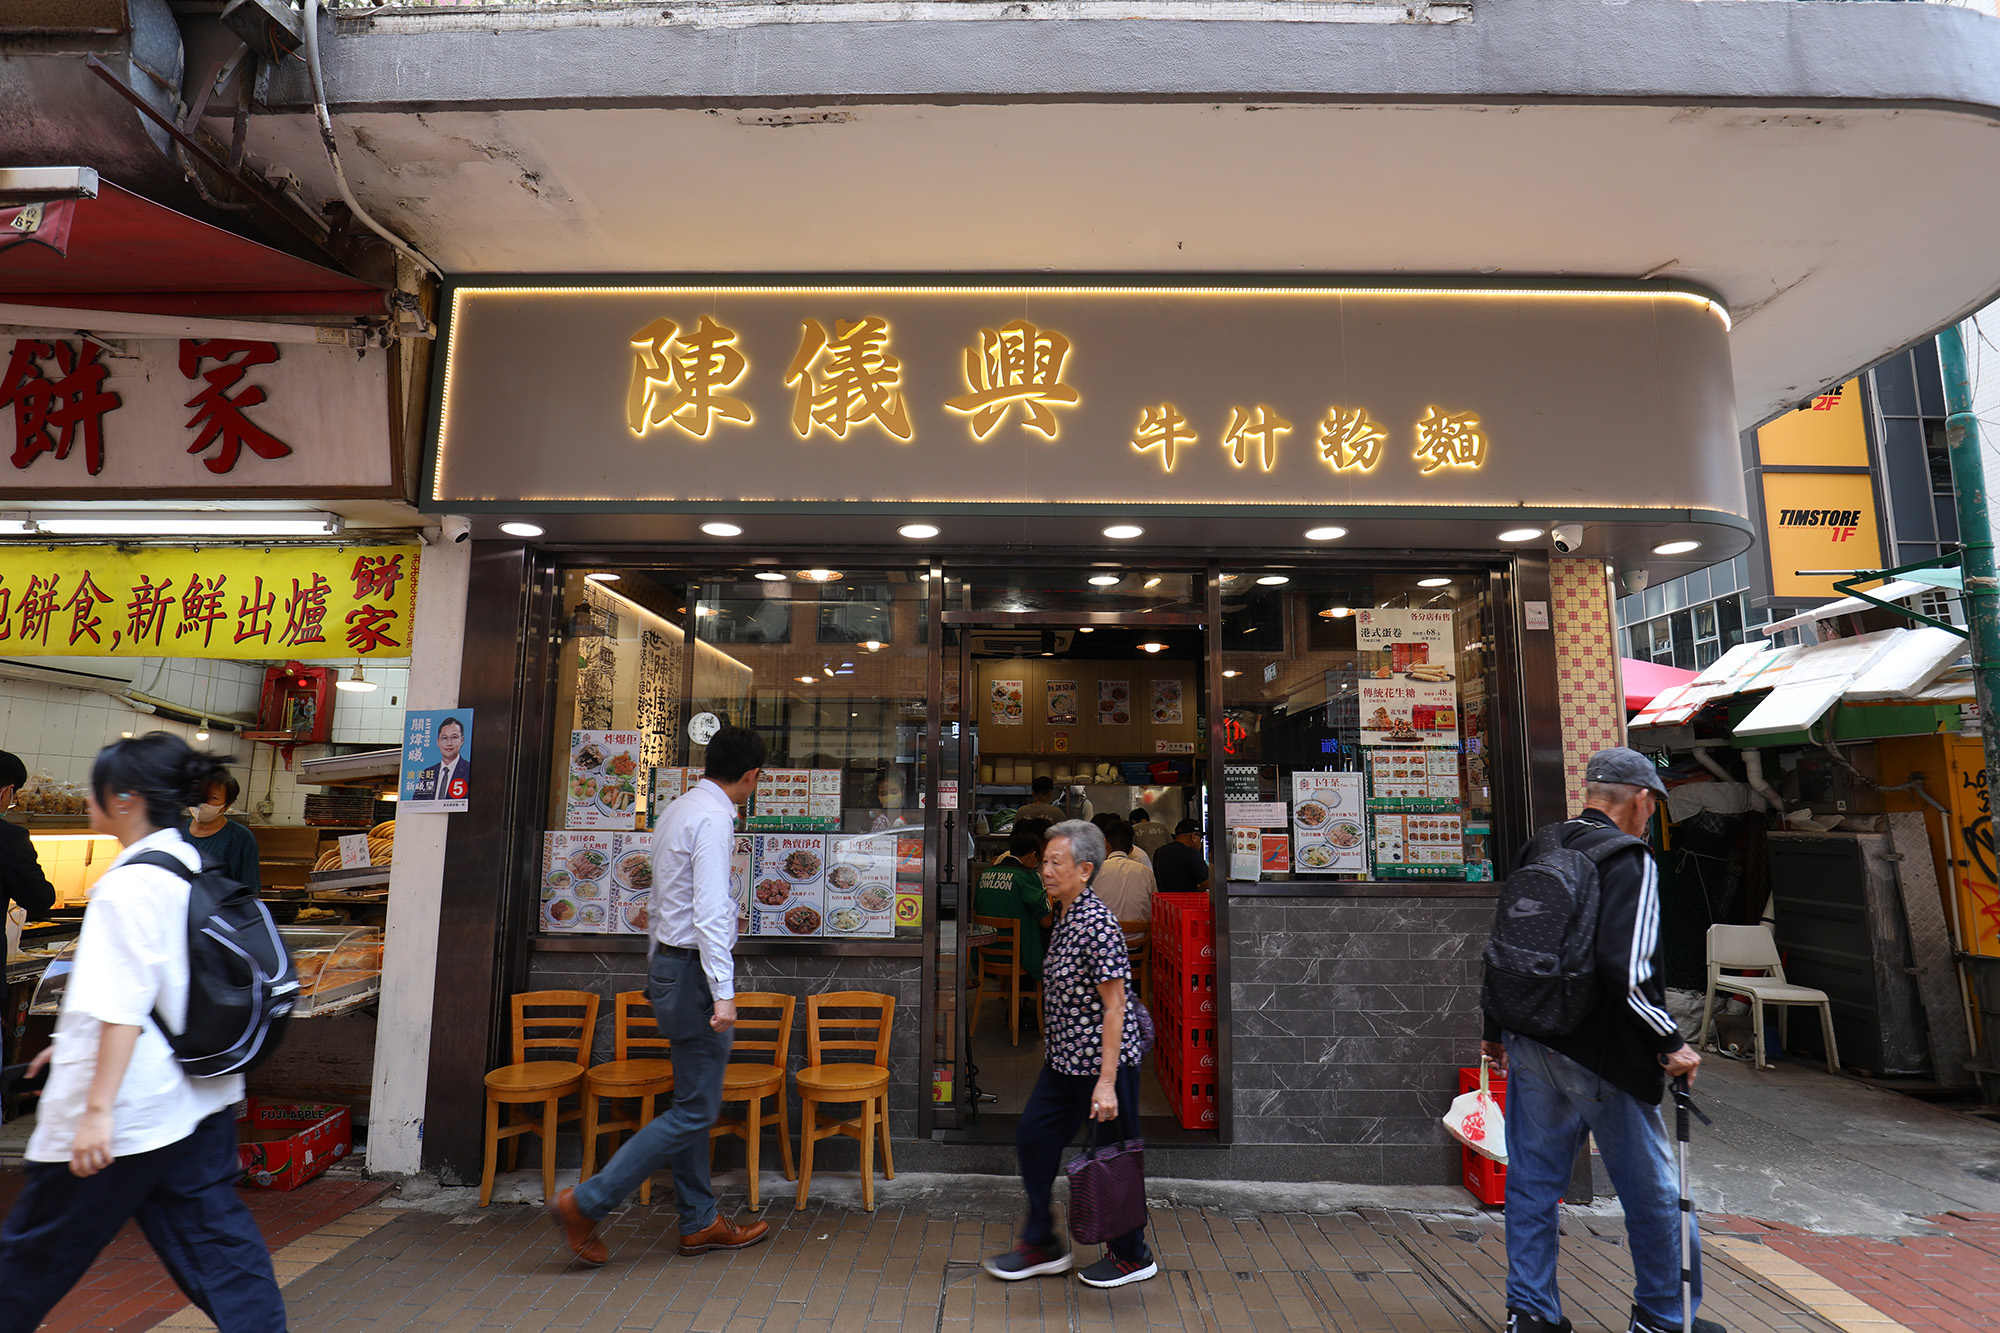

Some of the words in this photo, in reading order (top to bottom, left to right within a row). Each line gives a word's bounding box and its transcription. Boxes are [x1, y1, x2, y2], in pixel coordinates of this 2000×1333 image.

[628, 315, 1081, 441] 陳儀興
[1132, 404, 1489, 475] 牛什粉麵
[0, 338, 293, 476] 餅家
[1813, 396, 1841, 411] 2F
[1779, 509, 1861, 527] TIMSTORE
[1831, 527, 1857, 542] 1F
[344, 553, 404, 655] 餅家
[1360, 627, 1402, 638] 港式蛋卷
[1363, 687, 1416, 698] 傳統花生糖
[604, 734, 637, 745] 炸爆佢
[452, 781, 464, 796] 5
[782, 838, 821, 849] 熱賣淨食
[997, 872, 1013, 881] YAN
[979, 880, 1012, 890] OWLOON
[261, 1110, 286, 1120] FUJI
[290, 1110, 325, 1120] APPLE
